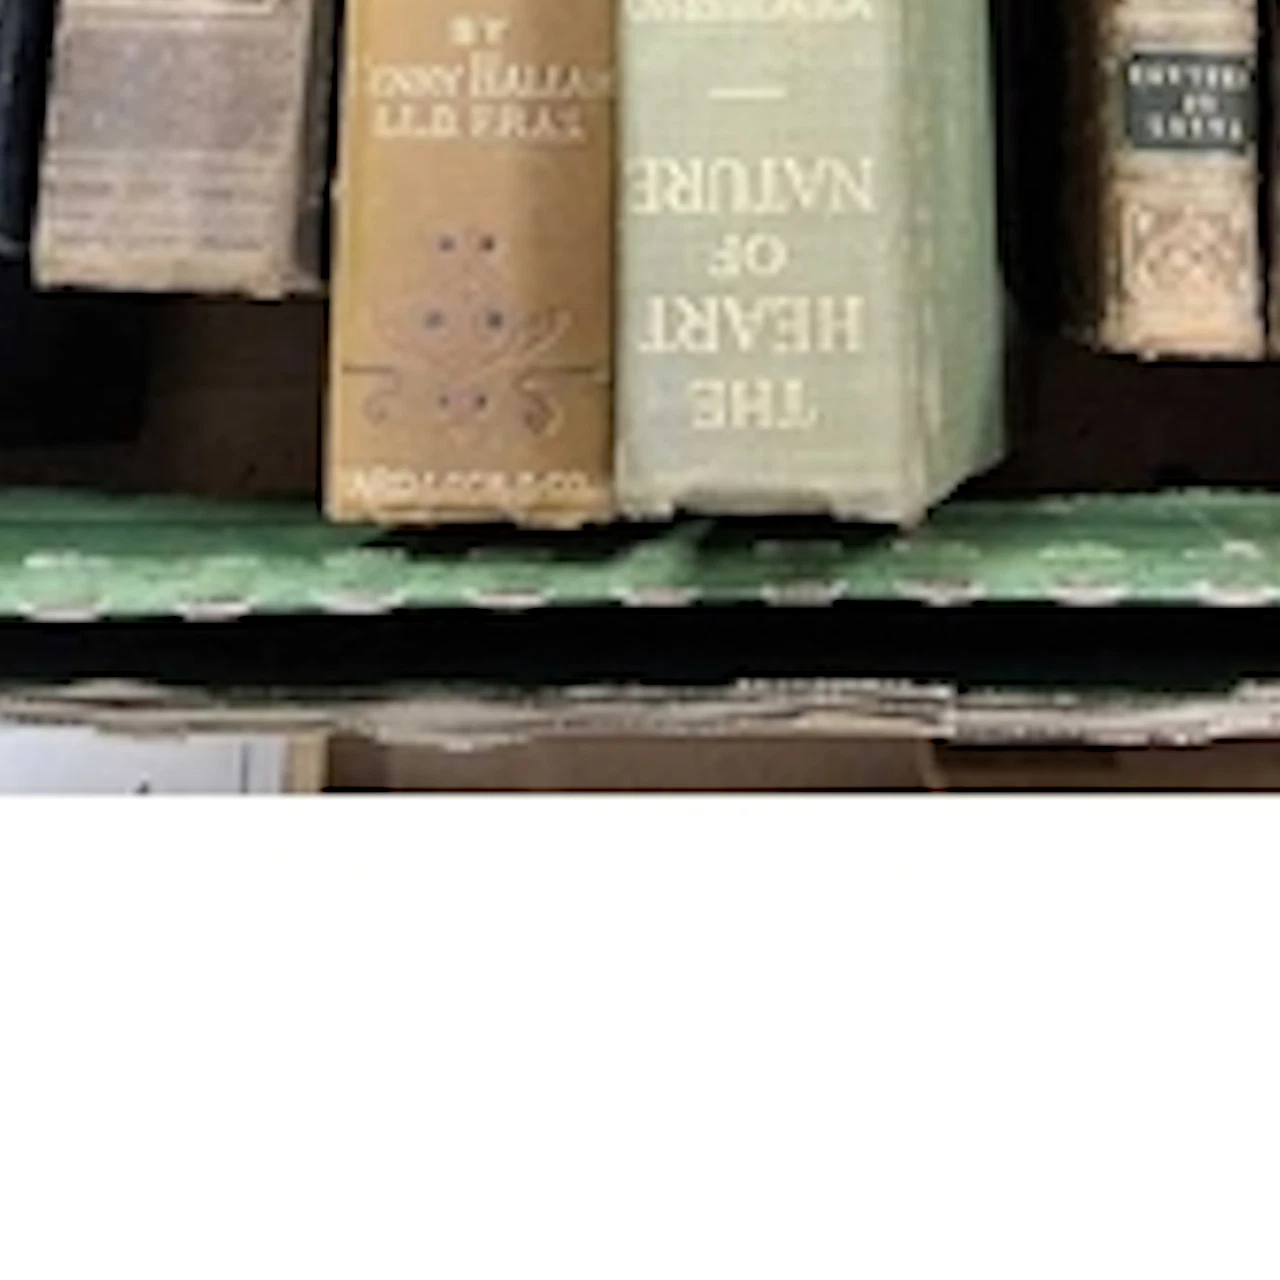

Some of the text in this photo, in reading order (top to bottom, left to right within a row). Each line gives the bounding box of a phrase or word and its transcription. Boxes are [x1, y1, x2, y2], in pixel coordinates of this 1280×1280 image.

[450, 16, 508, 47] BY
[626, 155, 878, 216] NATURE
[706, 232, 790, 278] OF
[637, 294, 867, 354] HEART
[690, 377, 820, 430] THE
